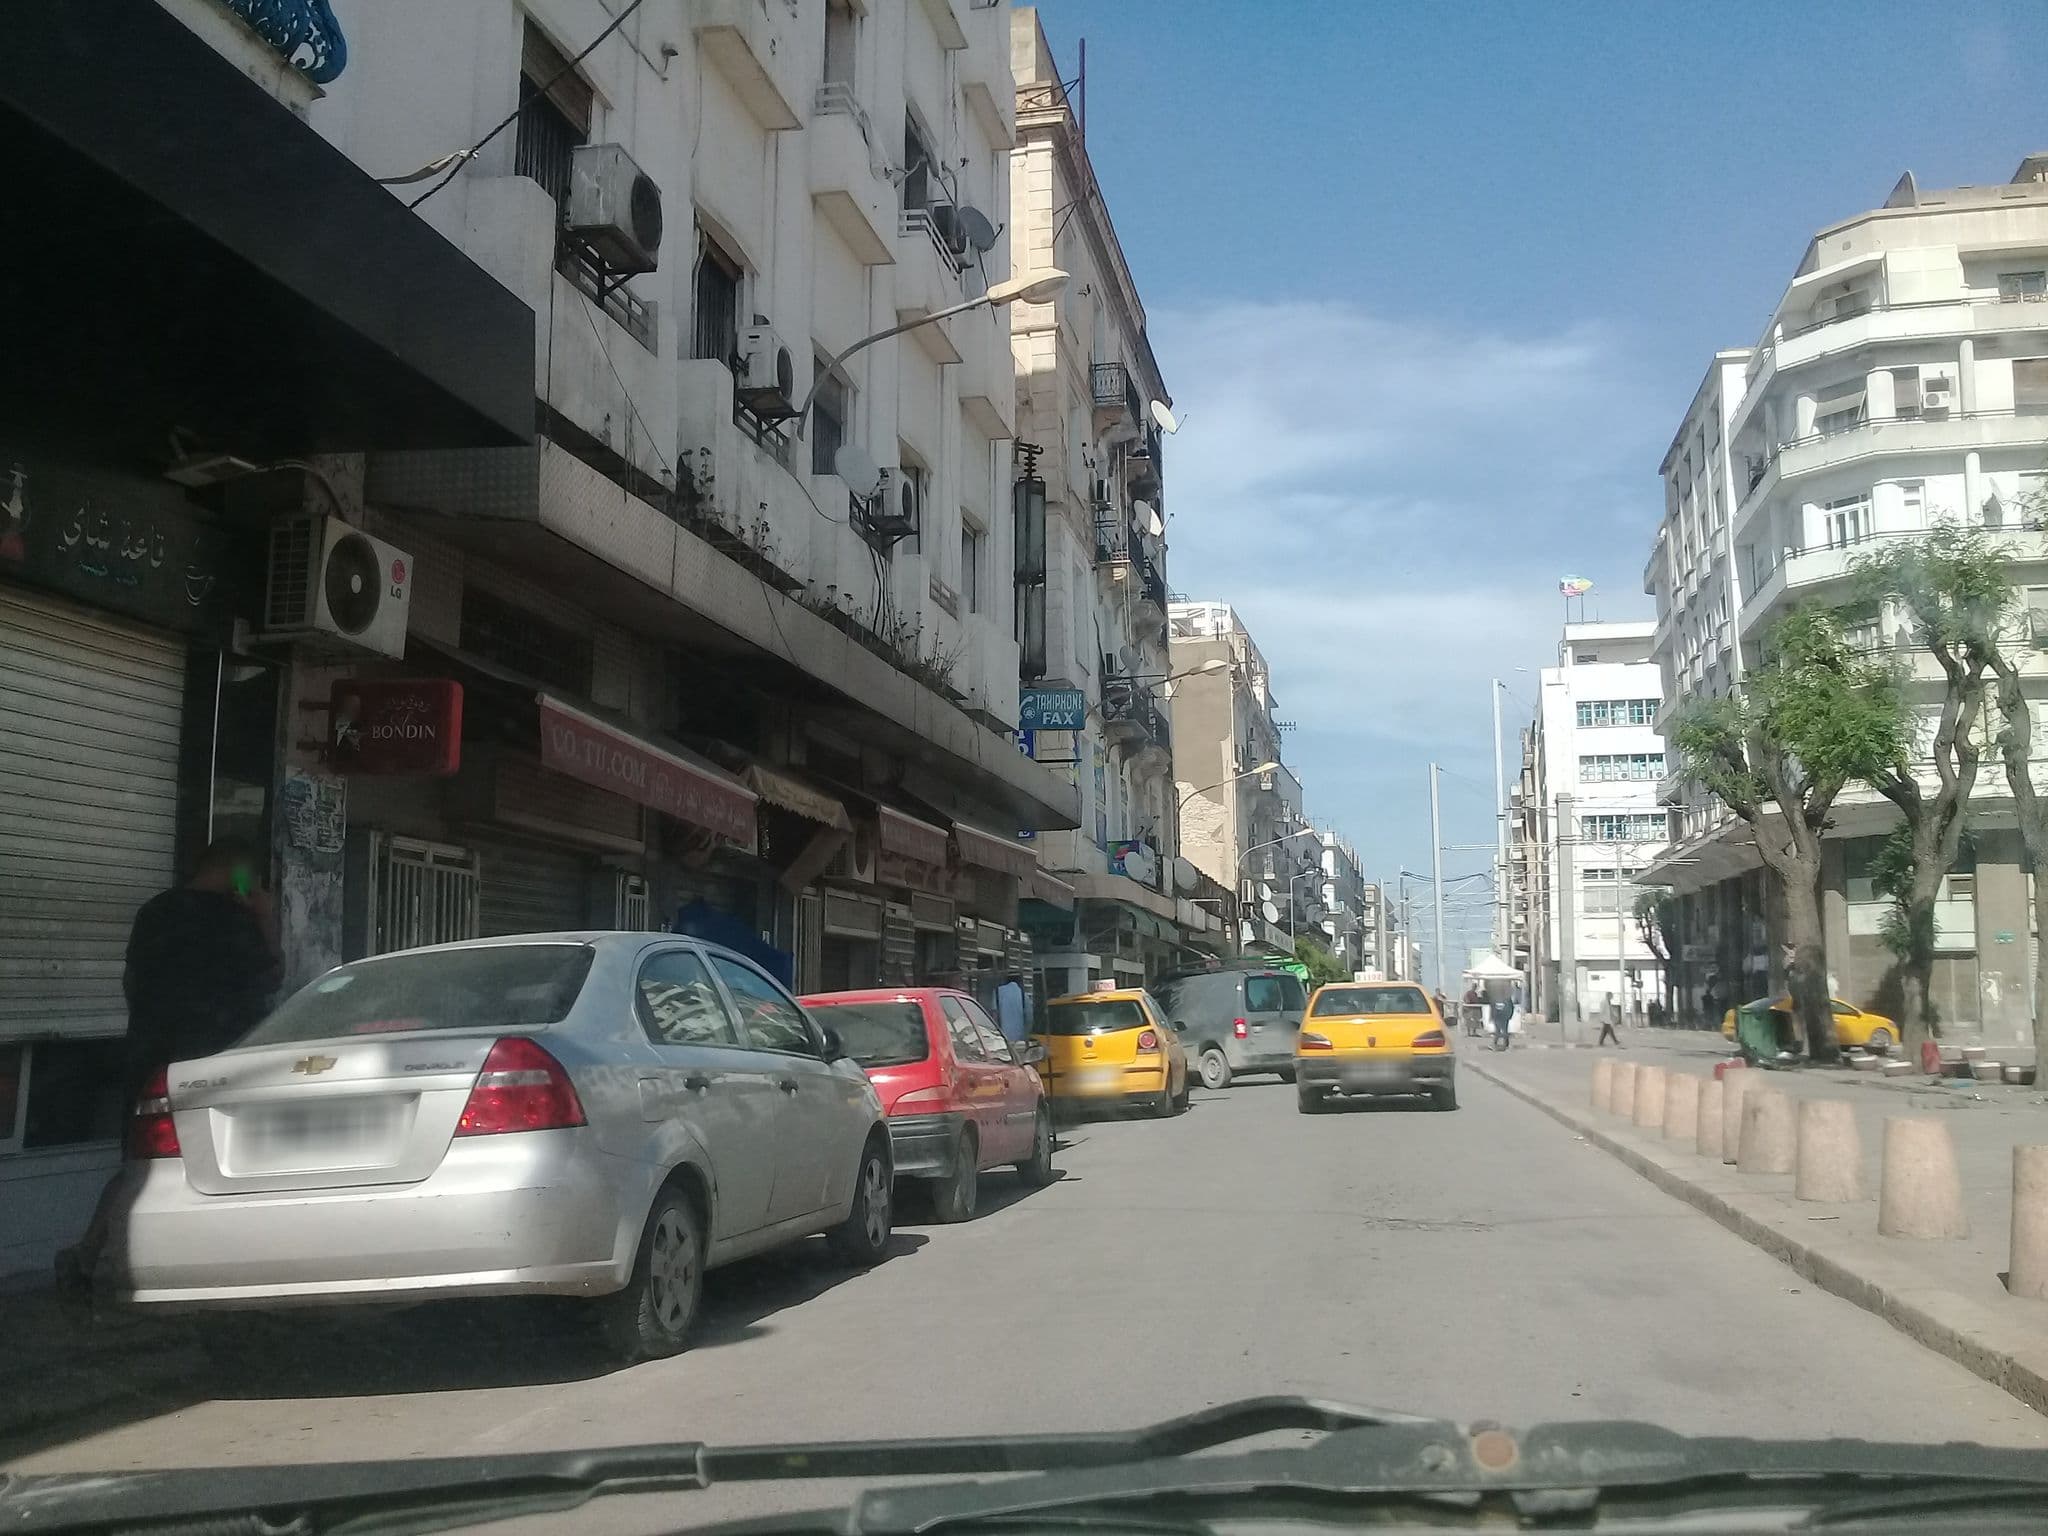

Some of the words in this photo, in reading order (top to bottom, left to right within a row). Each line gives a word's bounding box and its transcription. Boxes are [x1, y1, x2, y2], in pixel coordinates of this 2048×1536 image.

[390, 585, 402, 600] LG
[1043, 711, 1074, 725] FAX
[371, 724, 437, 741] BONDIN
